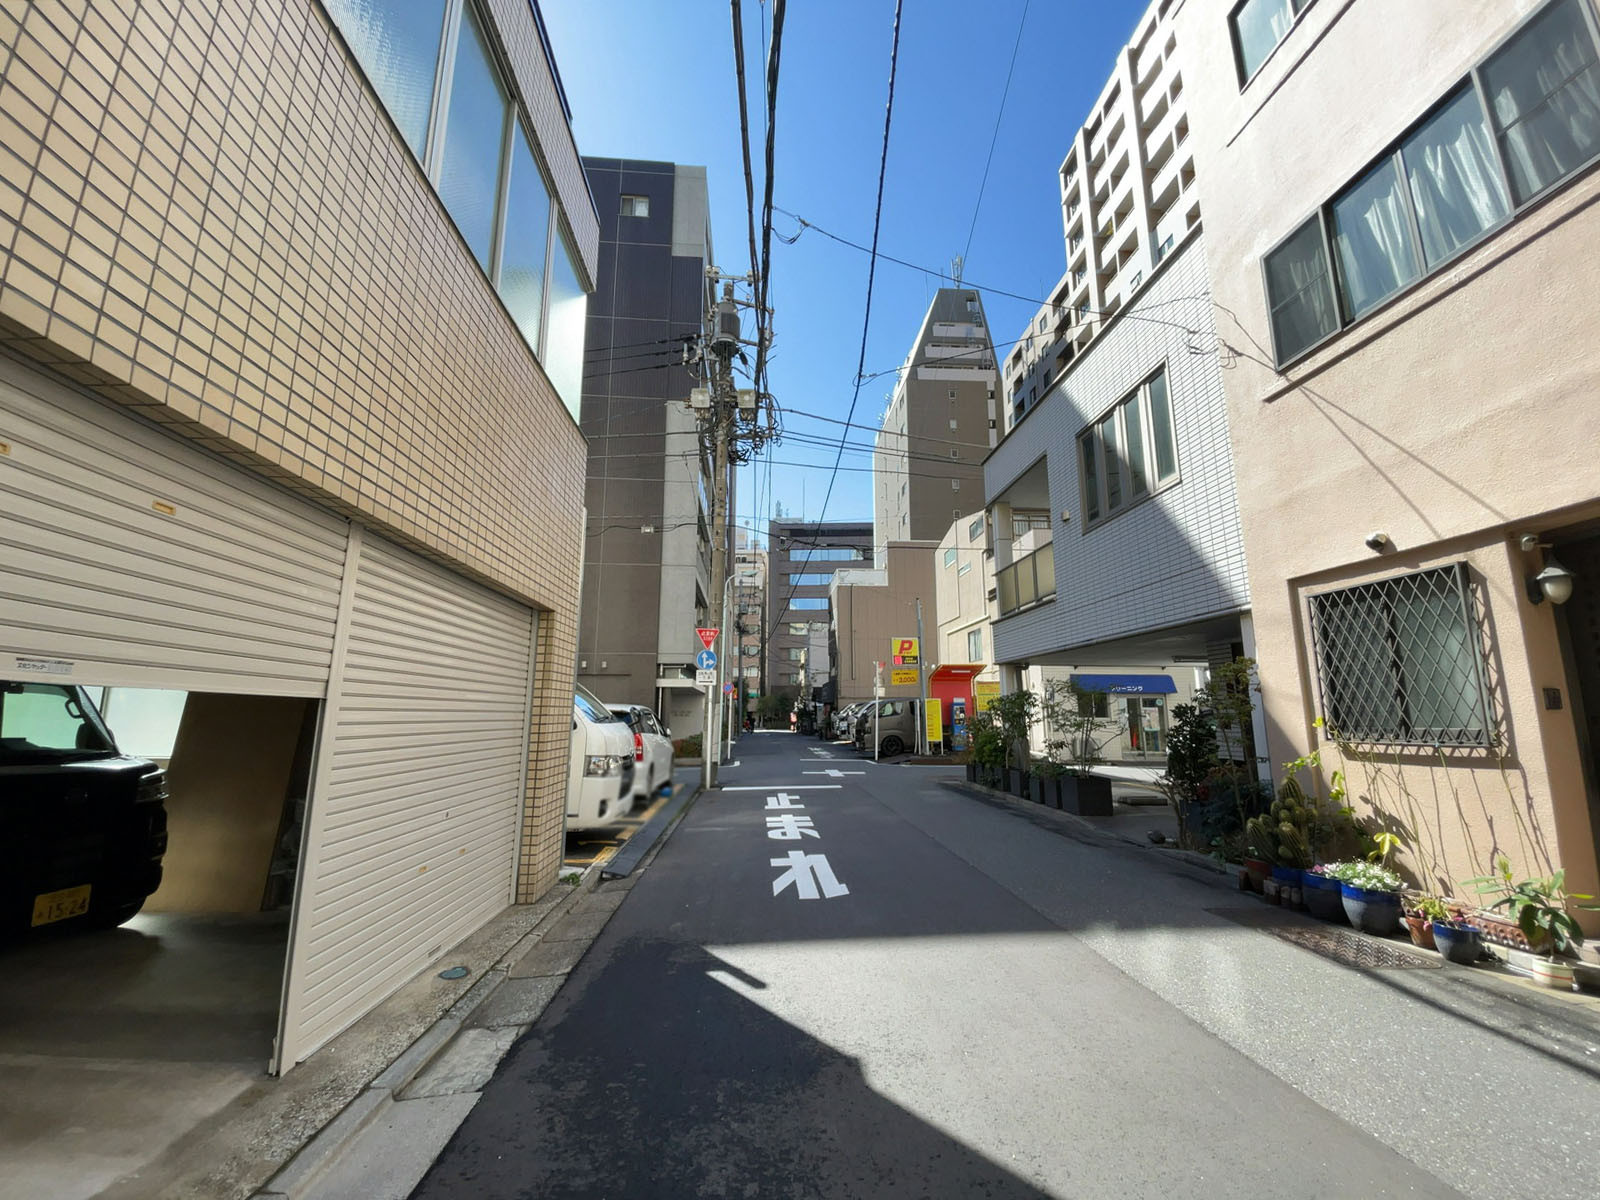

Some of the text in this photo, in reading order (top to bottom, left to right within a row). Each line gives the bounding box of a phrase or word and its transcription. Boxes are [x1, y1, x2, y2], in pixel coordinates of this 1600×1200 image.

[898, 640, 913, 655] P
[764, 793, 850, 900] 止まれ
